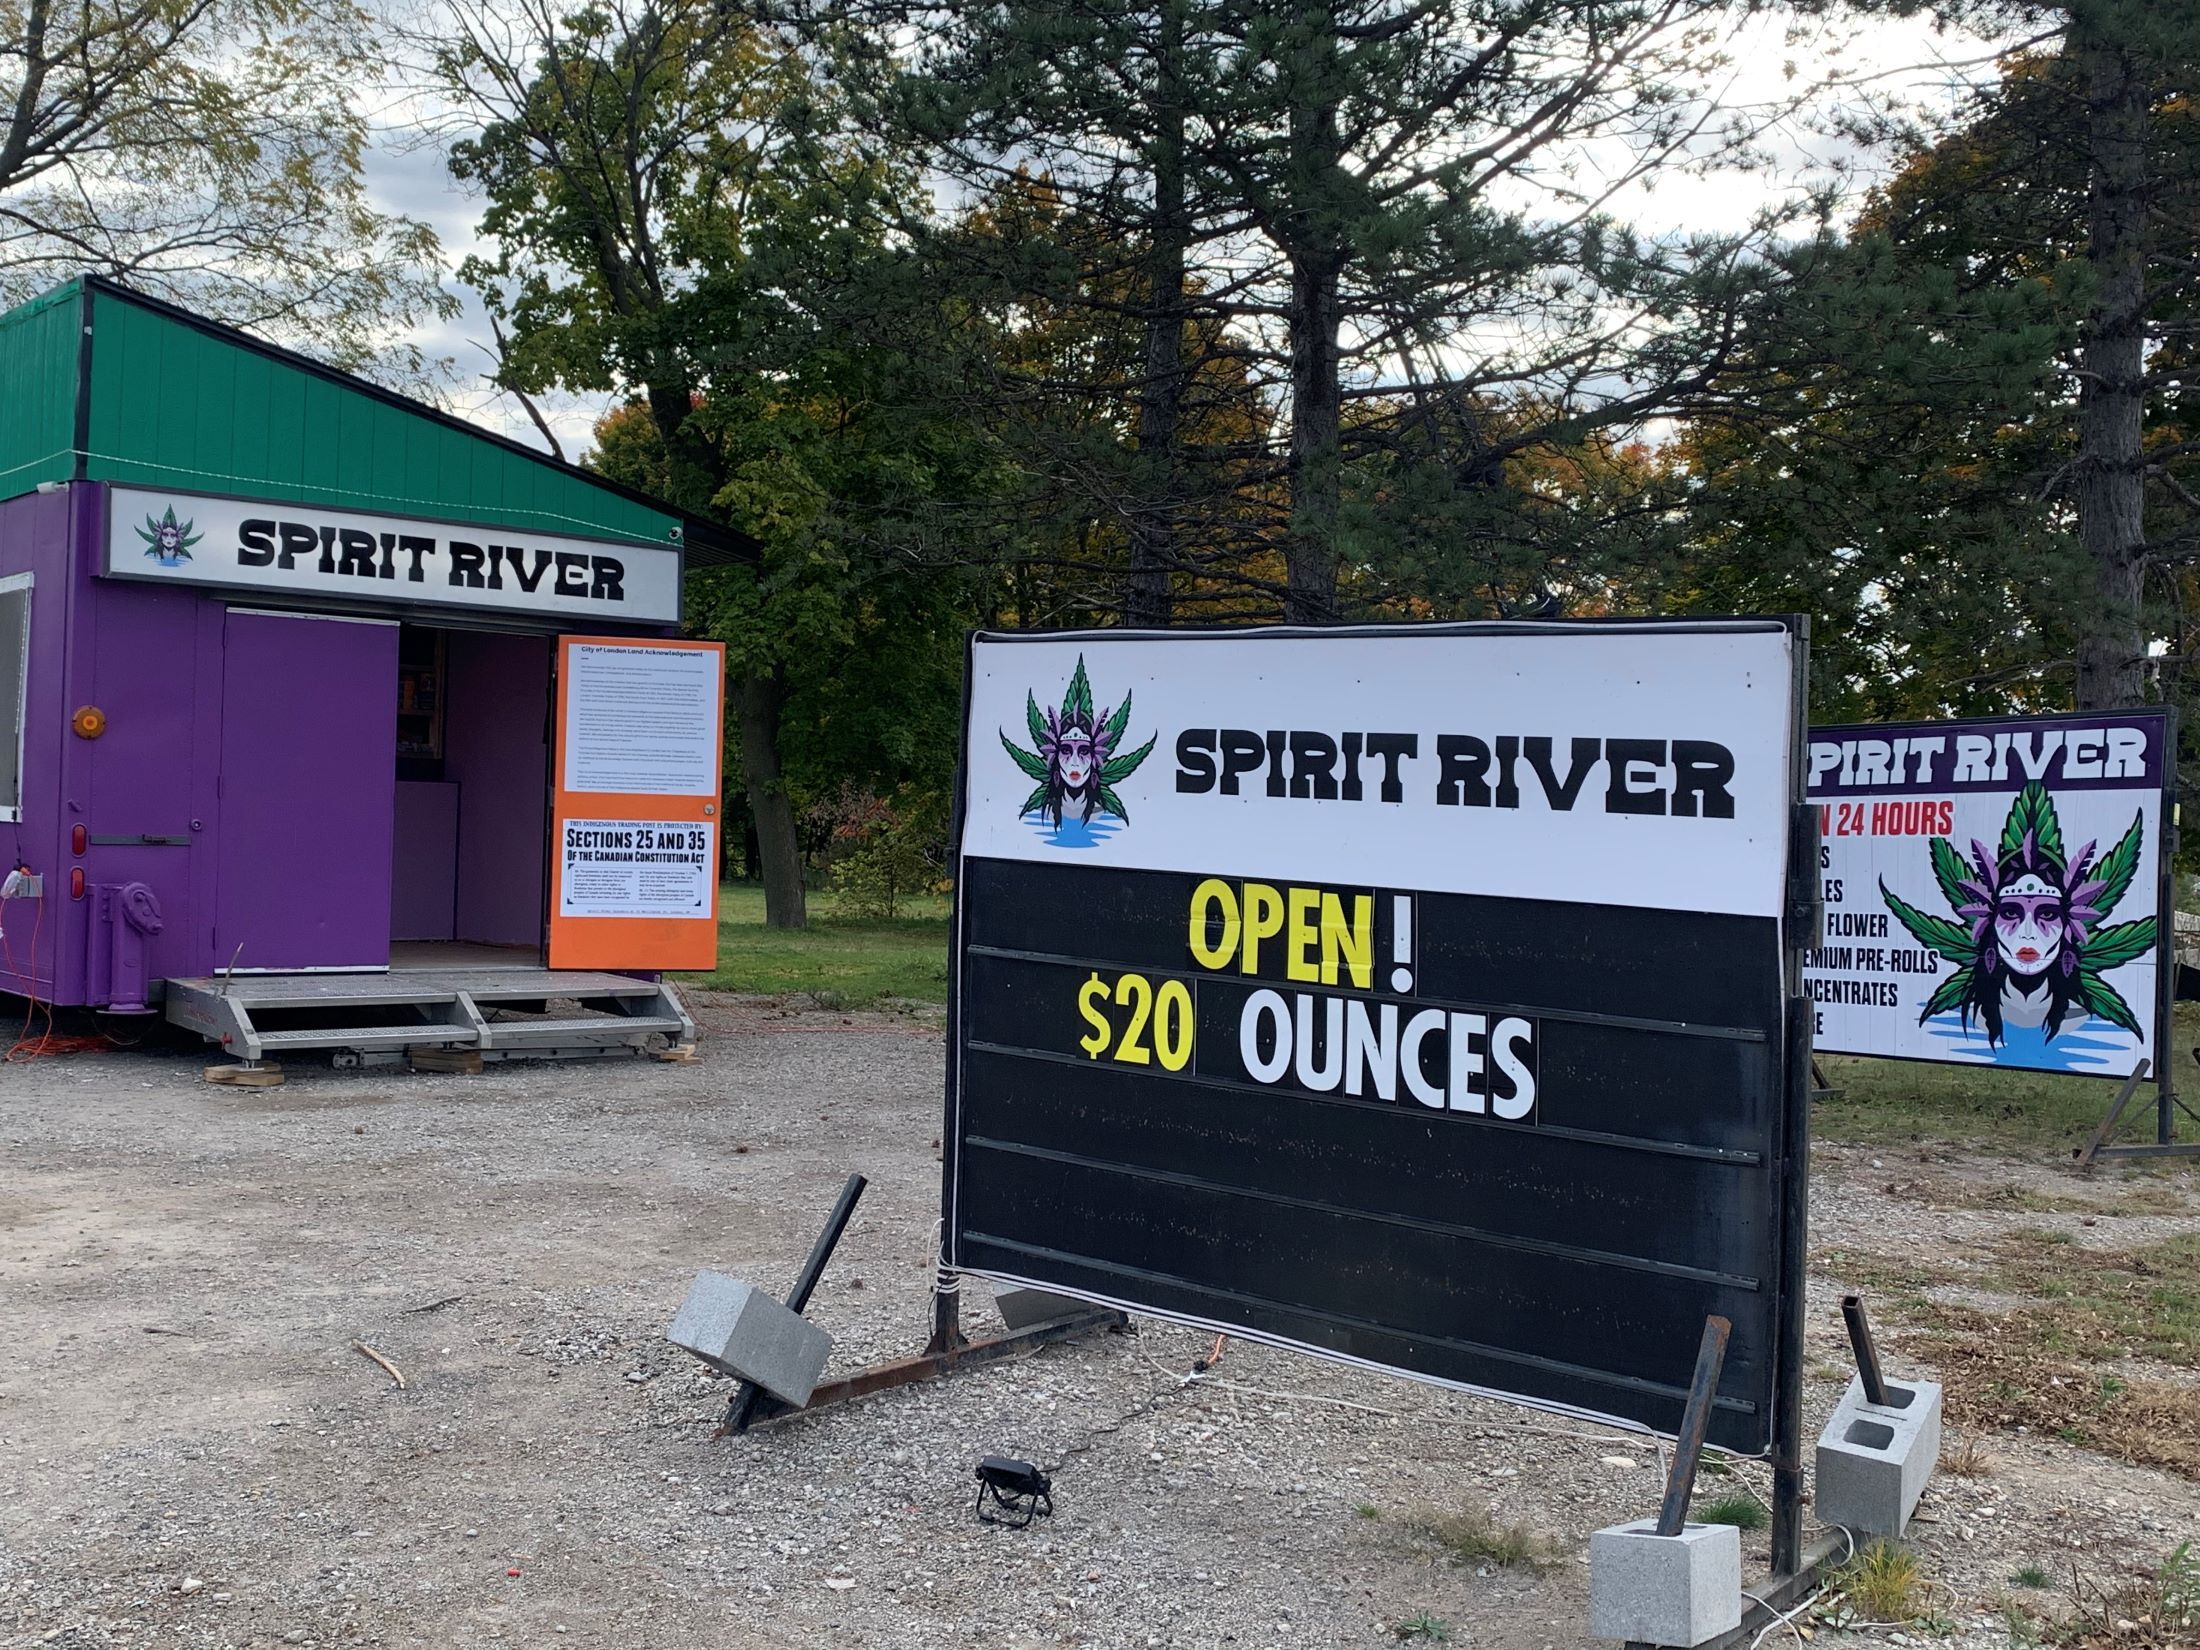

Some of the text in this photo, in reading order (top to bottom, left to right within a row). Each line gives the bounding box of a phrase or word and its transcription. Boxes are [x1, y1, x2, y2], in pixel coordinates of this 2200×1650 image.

[238, 518, 625, 601] SPIRIT RIVER
[645, 650, 703, 658] Acknowledgement
[1175, 729, 1736, 819] SPIRIT RIVER
[1807, 728, 2148, 787] PIRIT RIVER
[1837, 803, 1865, 836] 24
[1872, 801, 1954, 836] HOURS
[636, 830, 653, 849] 25
[688, 831, 705, 850] 35
[1827, 913, 1888, 938] FLOWER
[1856, 948, 1939, 974] PRE-ROLLS
[1077, 973, 1537, 1121] $20 OUNCES
